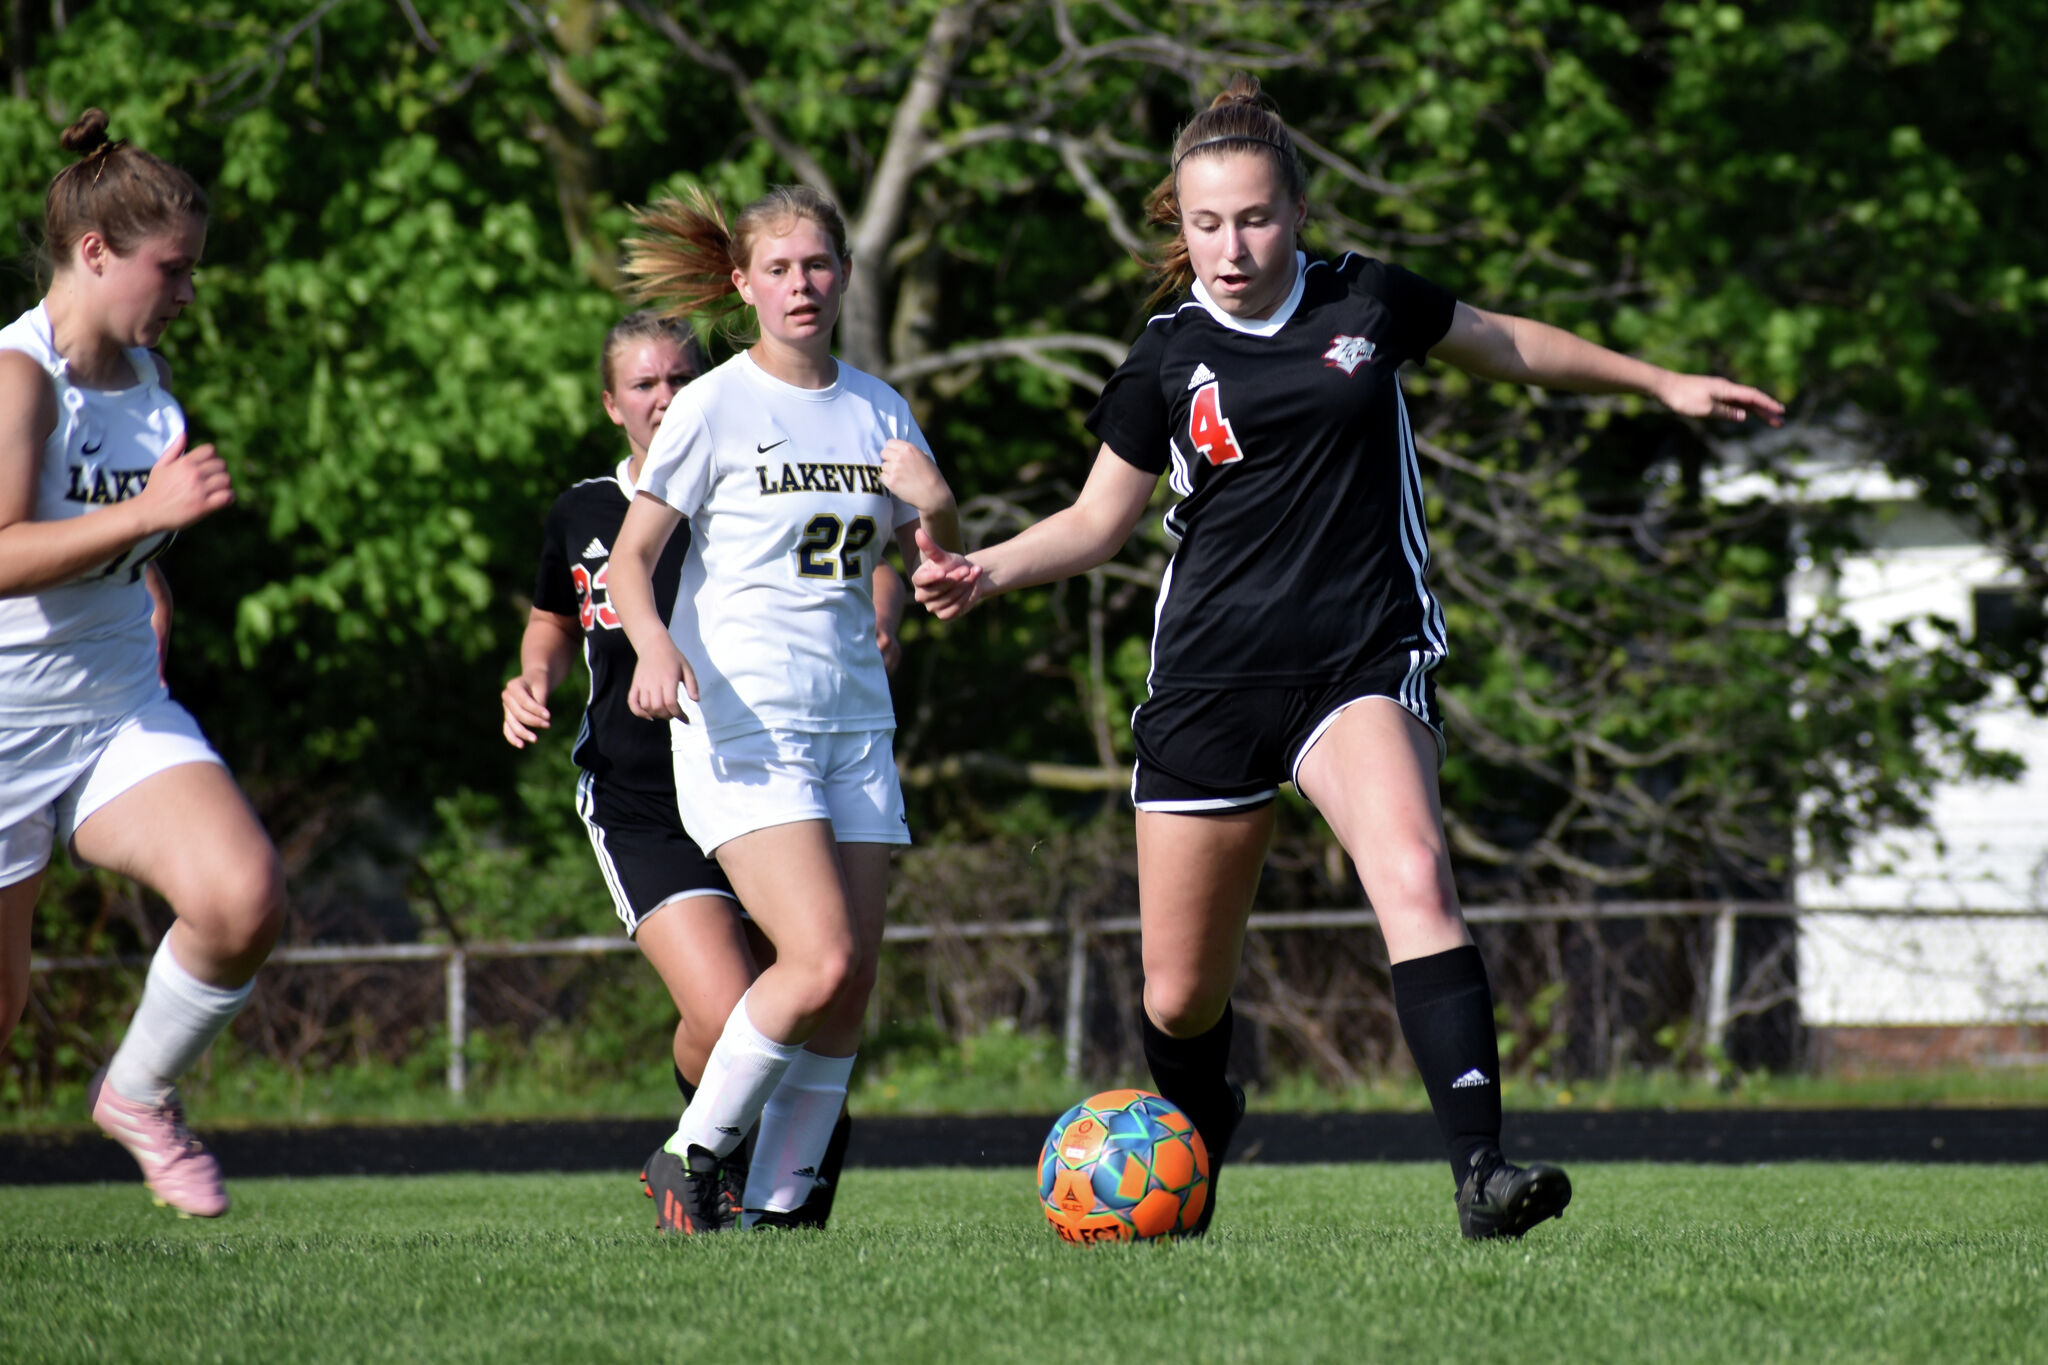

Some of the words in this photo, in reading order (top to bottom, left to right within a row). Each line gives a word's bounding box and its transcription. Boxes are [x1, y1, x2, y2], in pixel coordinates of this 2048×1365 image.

[1189, 381, 1244, 466] 4
[755, 462, 891, 498] LAKEVIE
[797, 512, 878, 581] 22
